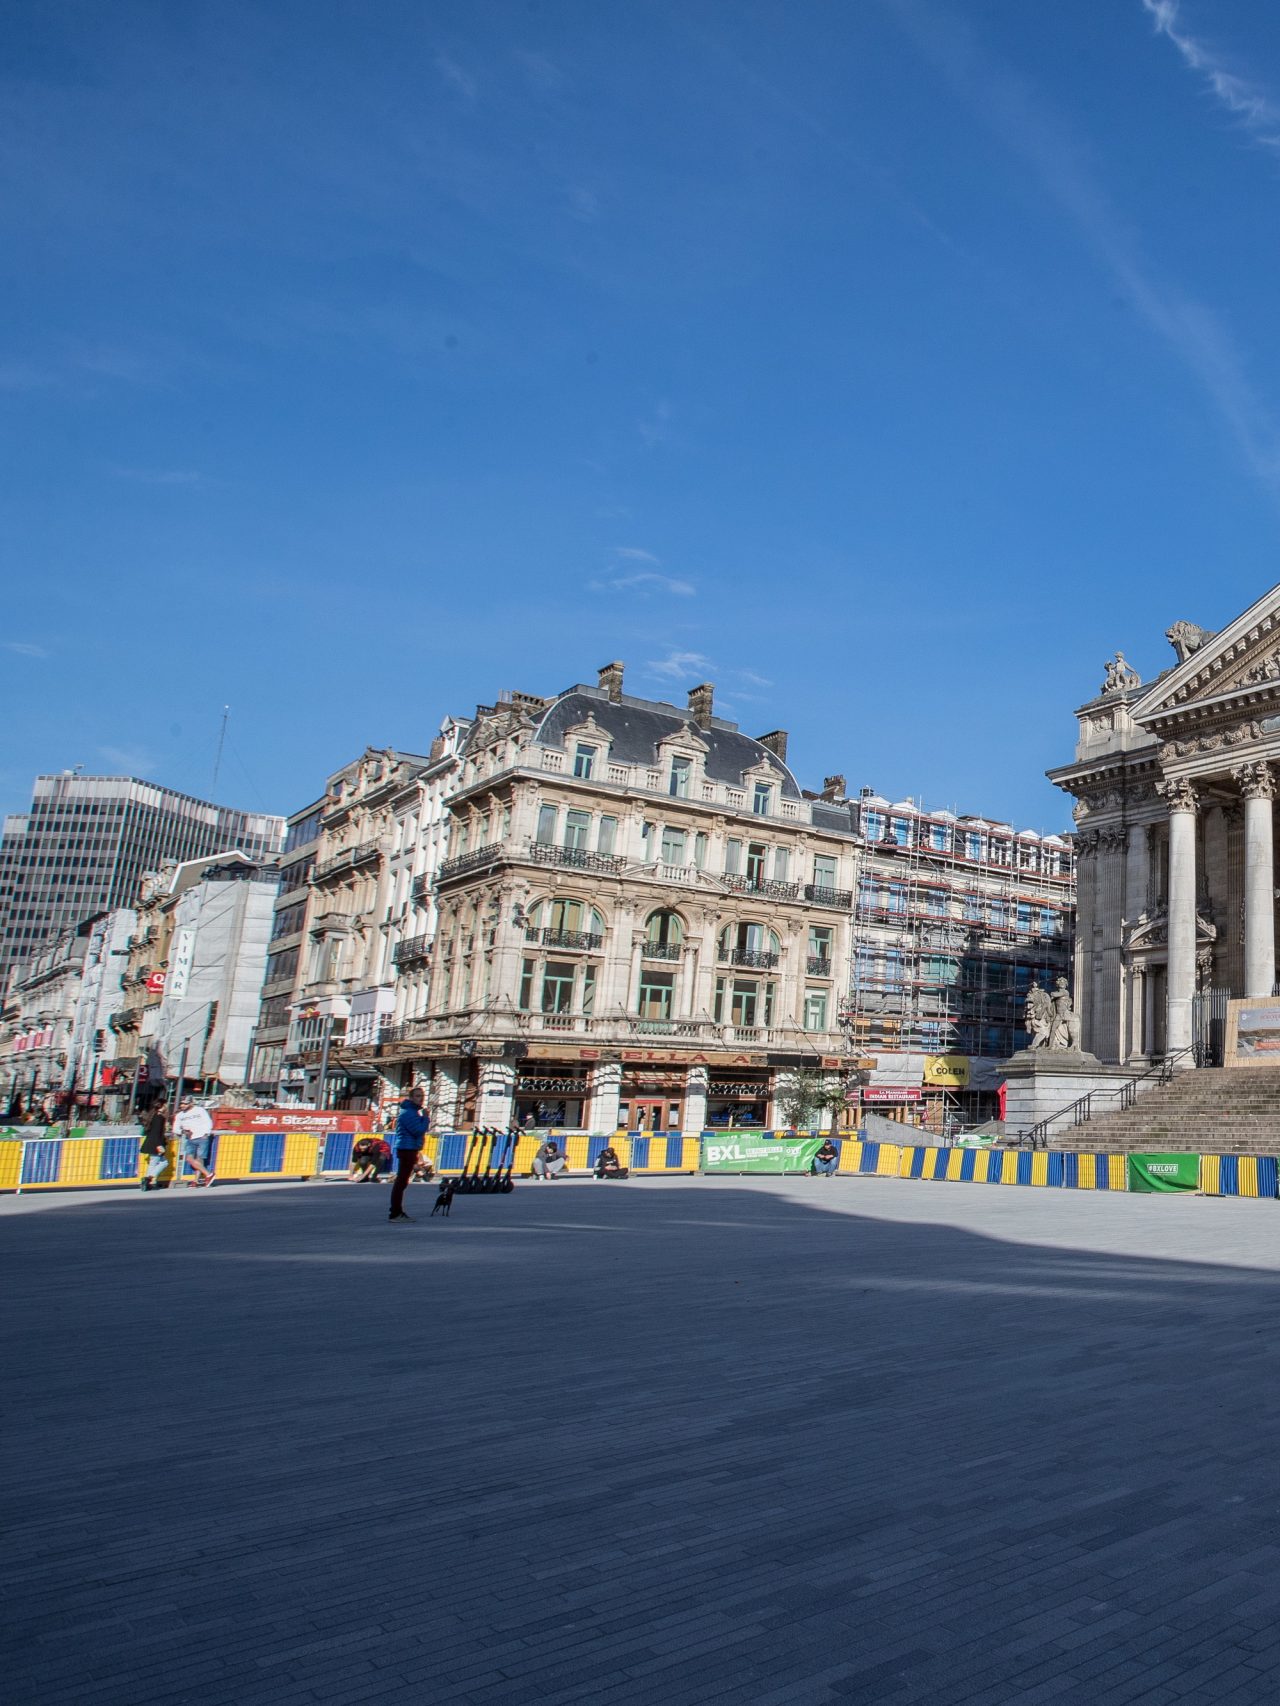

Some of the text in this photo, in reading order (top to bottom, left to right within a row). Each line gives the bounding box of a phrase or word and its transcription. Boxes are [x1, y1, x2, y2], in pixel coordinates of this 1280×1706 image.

[174, 933, 191, 990] VIMAR
[936, 1067, 965, 1076] COLEN
[707, 1144, 746, 1162] BXL
